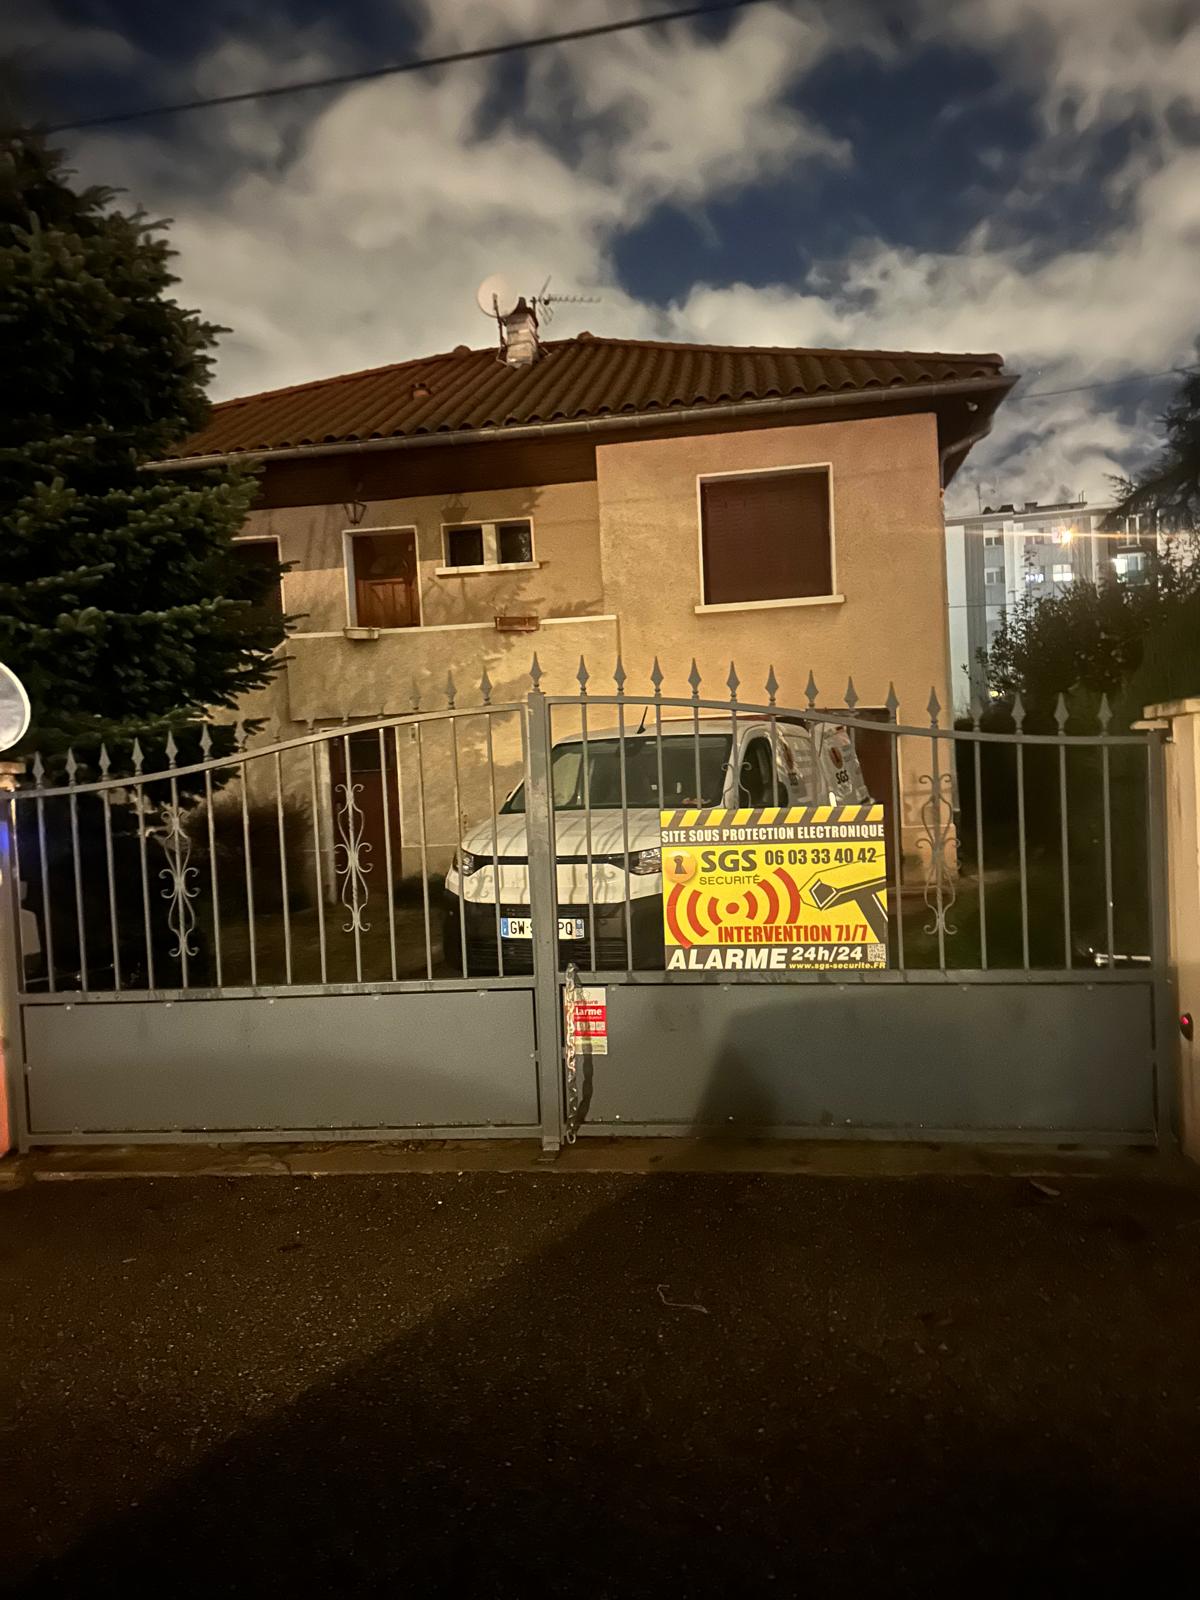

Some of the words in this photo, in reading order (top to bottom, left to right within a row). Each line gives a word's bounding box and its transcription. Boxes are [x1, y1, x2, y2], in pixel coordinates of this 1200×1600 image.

[661, 829, 686, 843] SITE
[689, 828, 719, 842] SOUS
[723, 825, 794, 841] PROTECTION
[797, 824, 884, 840] ELECTRONIQUE
[701, 849, 757, 872] SGS
[765, 850, 785, 866] 06
[788, 849, 808, 865] 03
[811, 849, 831, 865] 33
[834, 848, 854, 864] 40
[857, 847, 877, 863] 42
[699, 873, 760, 886] SECURITÉ
[718, 925, 832, 943] INTERVENTION
[835, 924, 868, 942] 7J/7
[667, 948, 787, 970] ALARME
[791, 946, 863, 962] 24h/24
[575, 1007, 602, 1016] larme
